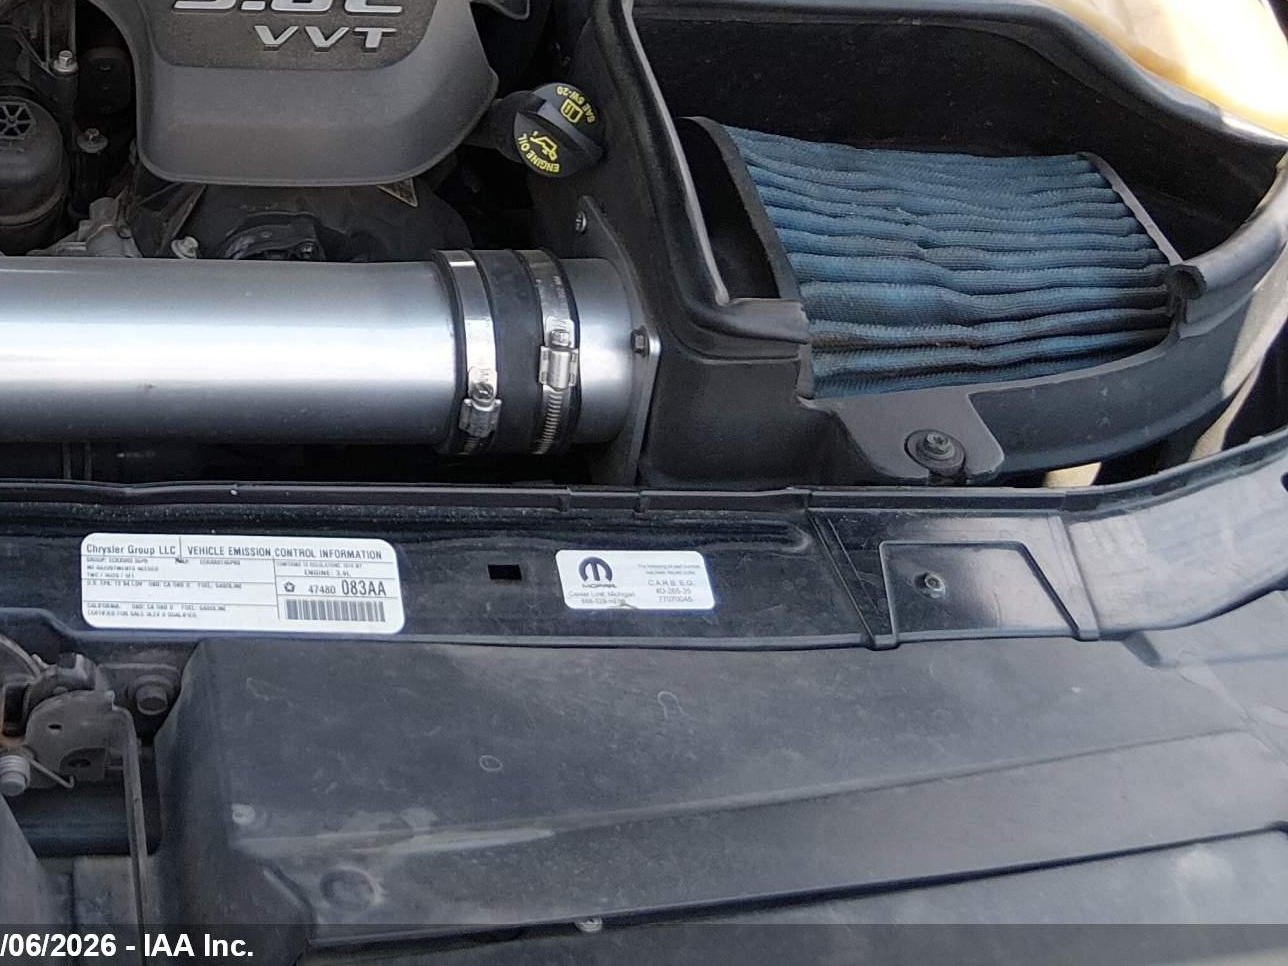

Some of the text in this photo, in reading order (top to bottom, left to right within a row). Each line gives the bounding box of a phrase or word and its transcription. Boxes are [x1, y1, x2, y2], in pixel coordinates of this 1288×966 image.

[254, 24, 398, 53] VVT
[517, 132, 561, 173] ENGINE OIL
[86, 543, 382, 560] Chrysler Group LLC VEHICLE EMISSION CONTROL INFORMATION
[341, 579, 387, 596] 083AA
